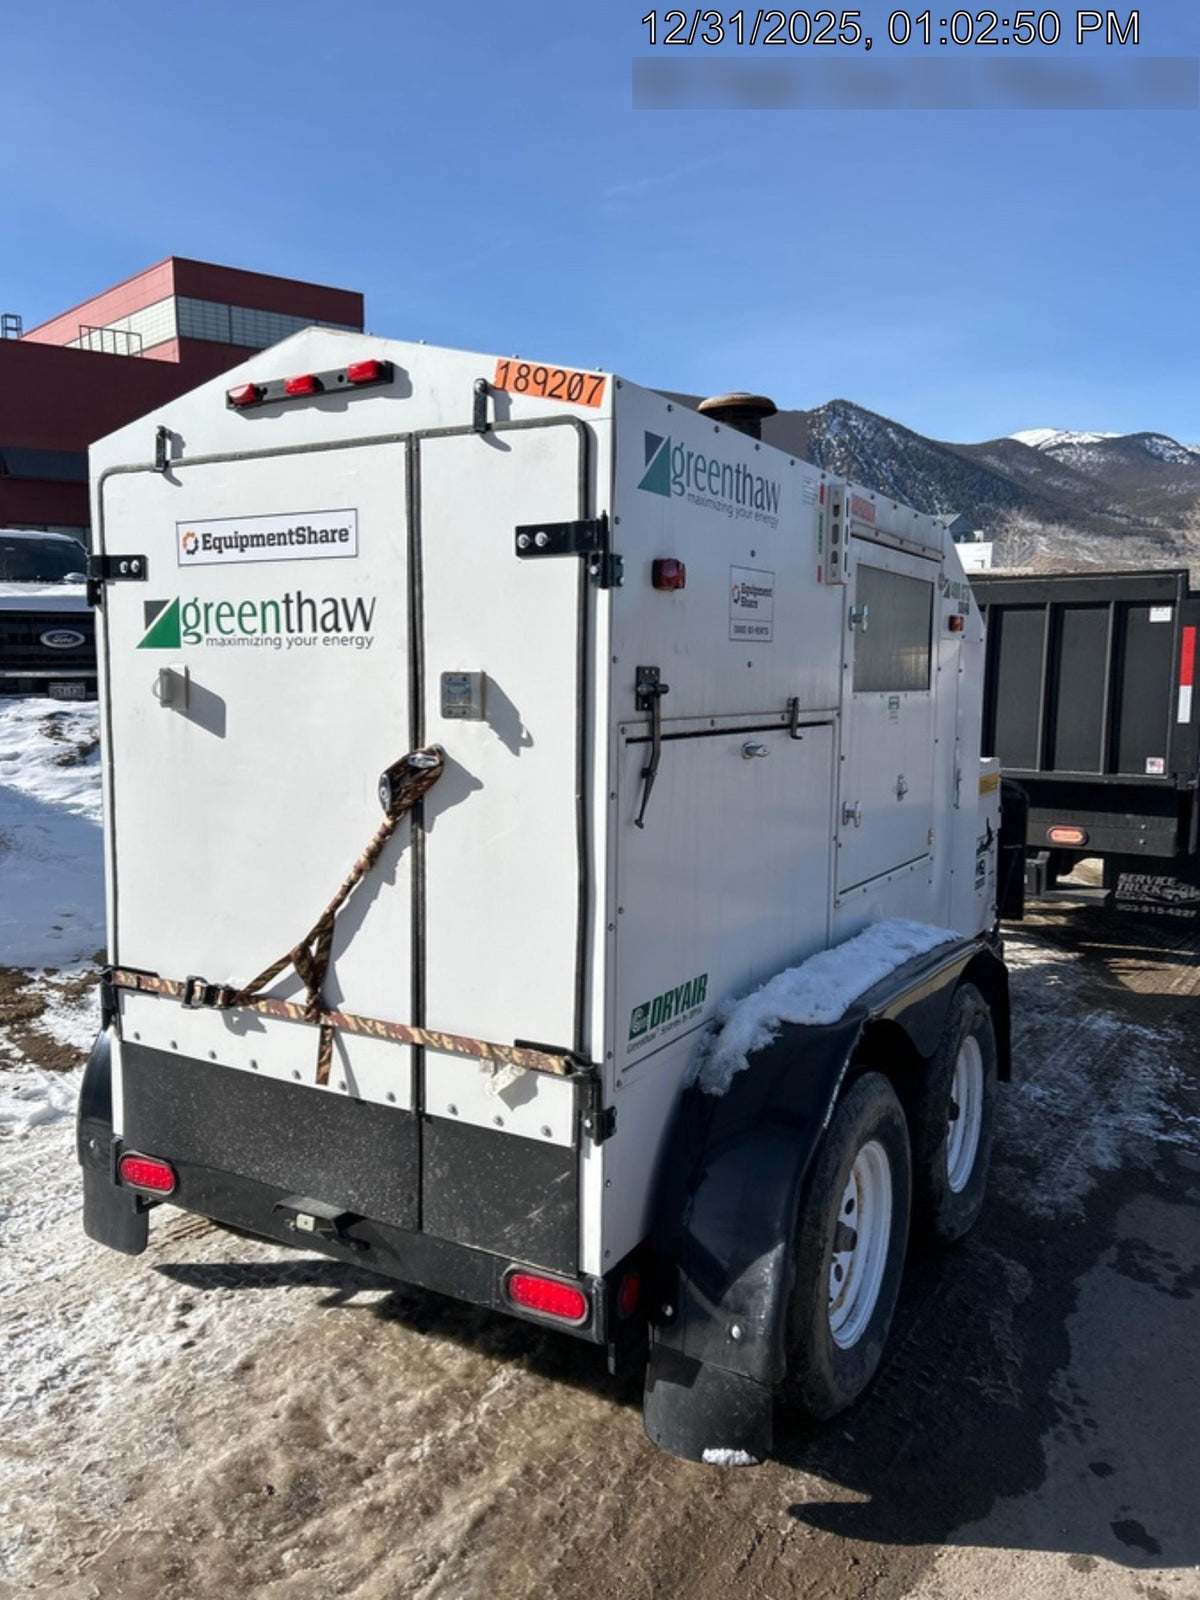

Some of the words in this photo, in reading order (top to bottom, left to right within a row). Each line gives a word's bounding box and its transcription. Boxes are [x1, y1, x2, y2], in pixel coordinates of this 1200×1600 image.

[493, 361, 606, 405] 189207
[671, 442, 780, 514] greenthaw
[201, 526, 350, 554] EquipmentShare
[181, 590, 377, 646] greenthaw
[205, 634, 283, 650] maximizing
[286, 636, 319, 650] your
[322, 635, 375, 650] energy
[650, 973, 708, 1030] DRYAIR
